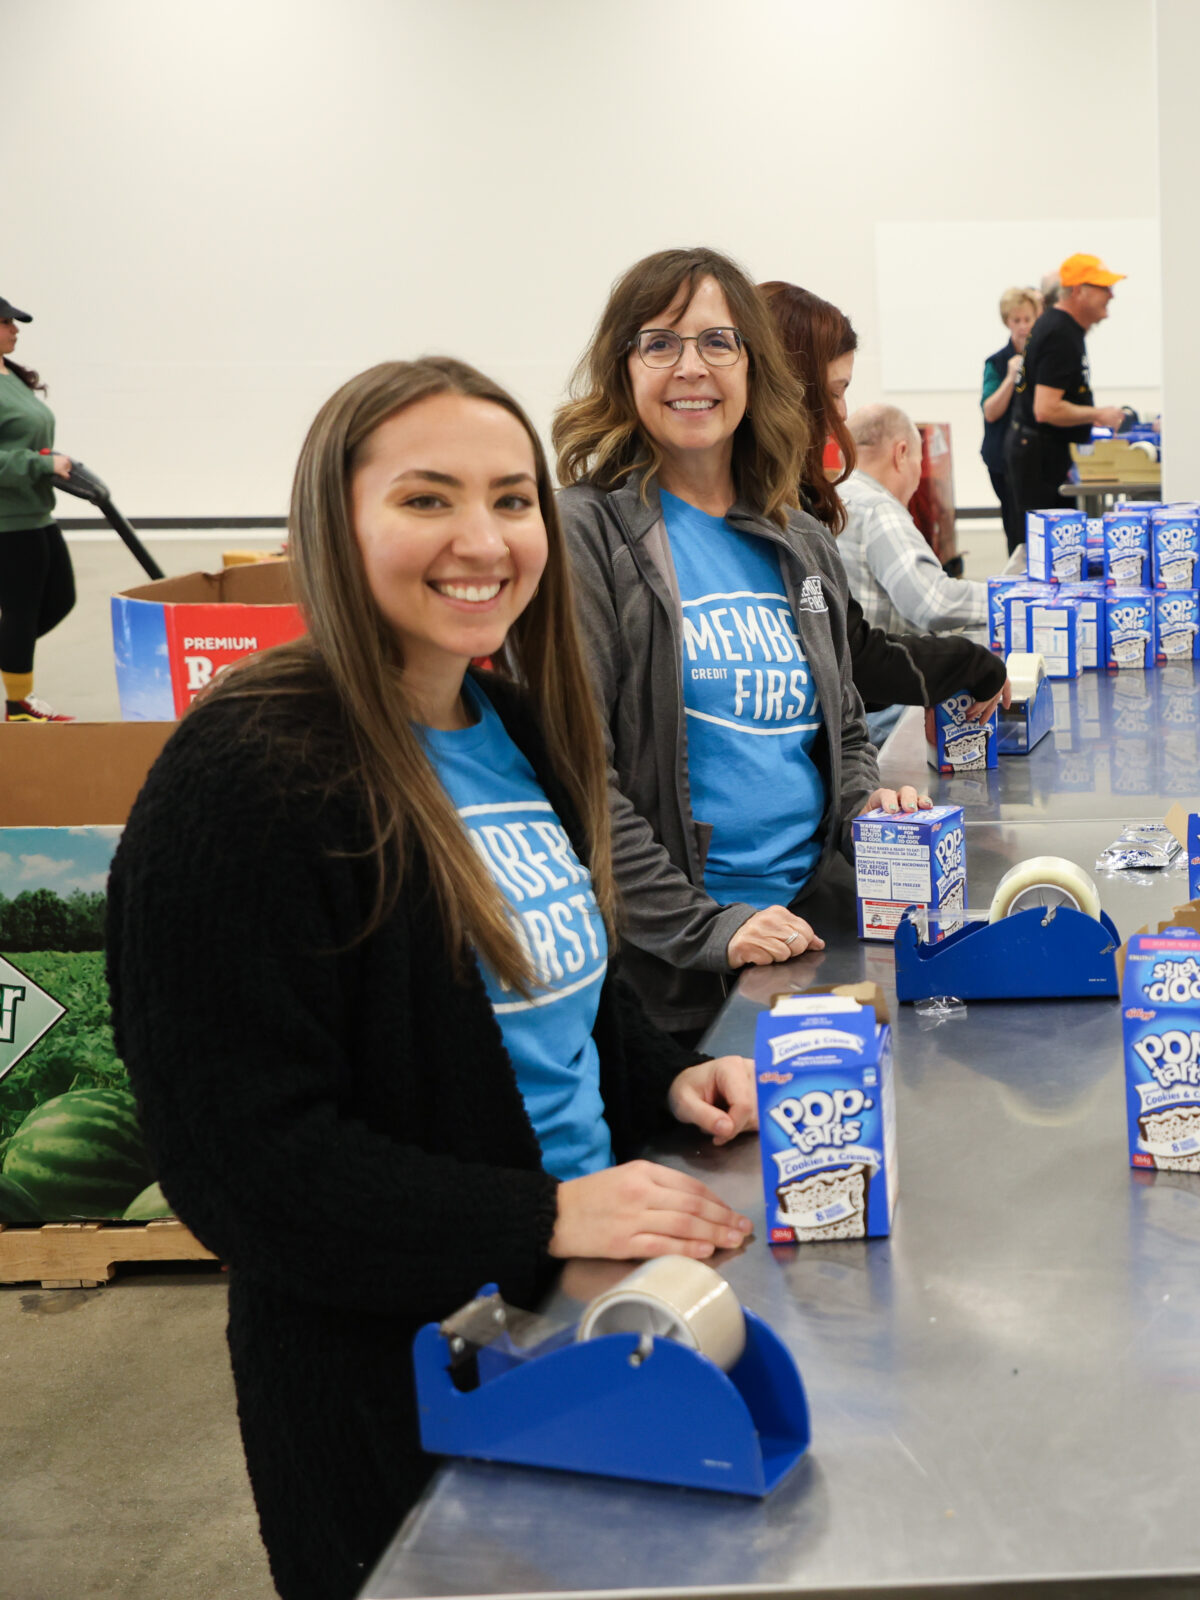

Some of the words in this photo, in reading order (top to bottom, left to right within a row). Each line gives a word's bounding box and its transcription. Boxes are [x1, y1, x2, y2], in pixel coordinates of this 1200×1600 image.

[184, 637, 258, 650] PREMIUM
[691, 668, 728, 680] CREDIT
[858, 869, 890, 877] HEATING
[1145, 1090, 1180, 1107] Cookies
[1183, 1090, 1191, 1099] &
[1171, 1143, 1180, 1153] 8
[784, 1158, 824, 1175] Cookies
